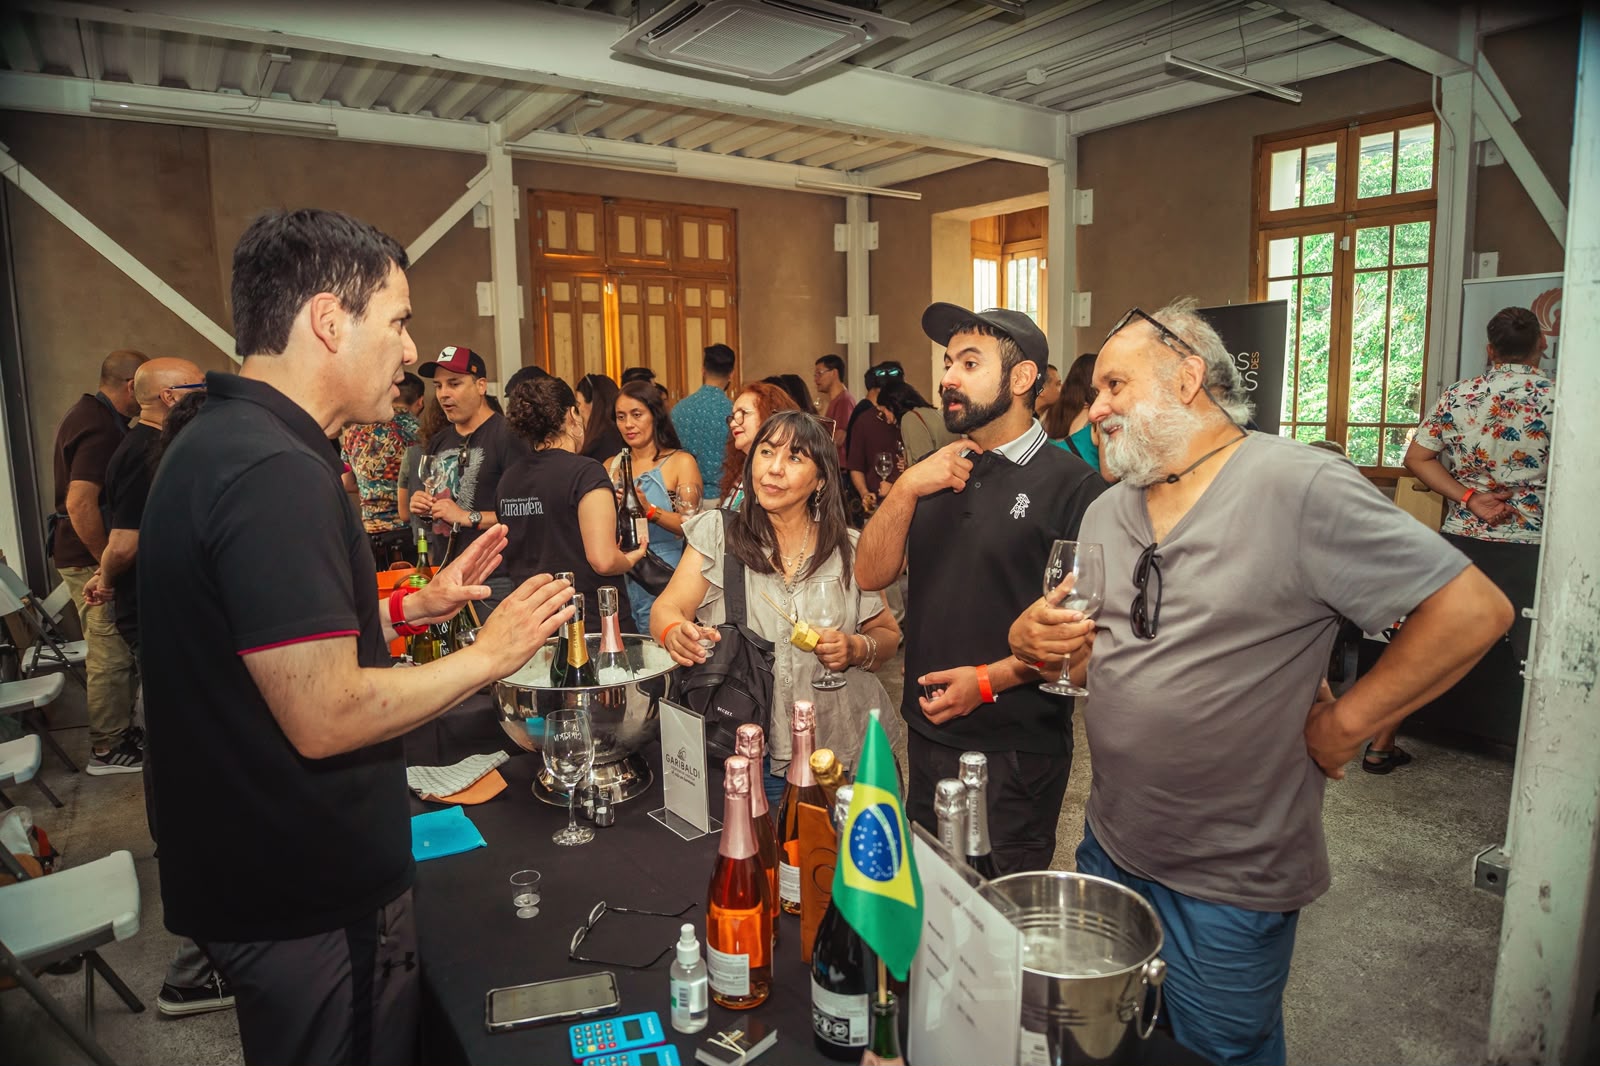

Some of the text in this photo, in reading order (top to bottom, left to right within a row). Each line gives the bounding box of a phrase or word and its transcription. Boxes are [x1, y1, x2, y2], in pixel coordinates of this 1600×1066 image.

[1251, 352, 1260, 370] DES
[500, 497, 544, 517] Curandera
[665, 753, 701, 779] GARIBALDI
